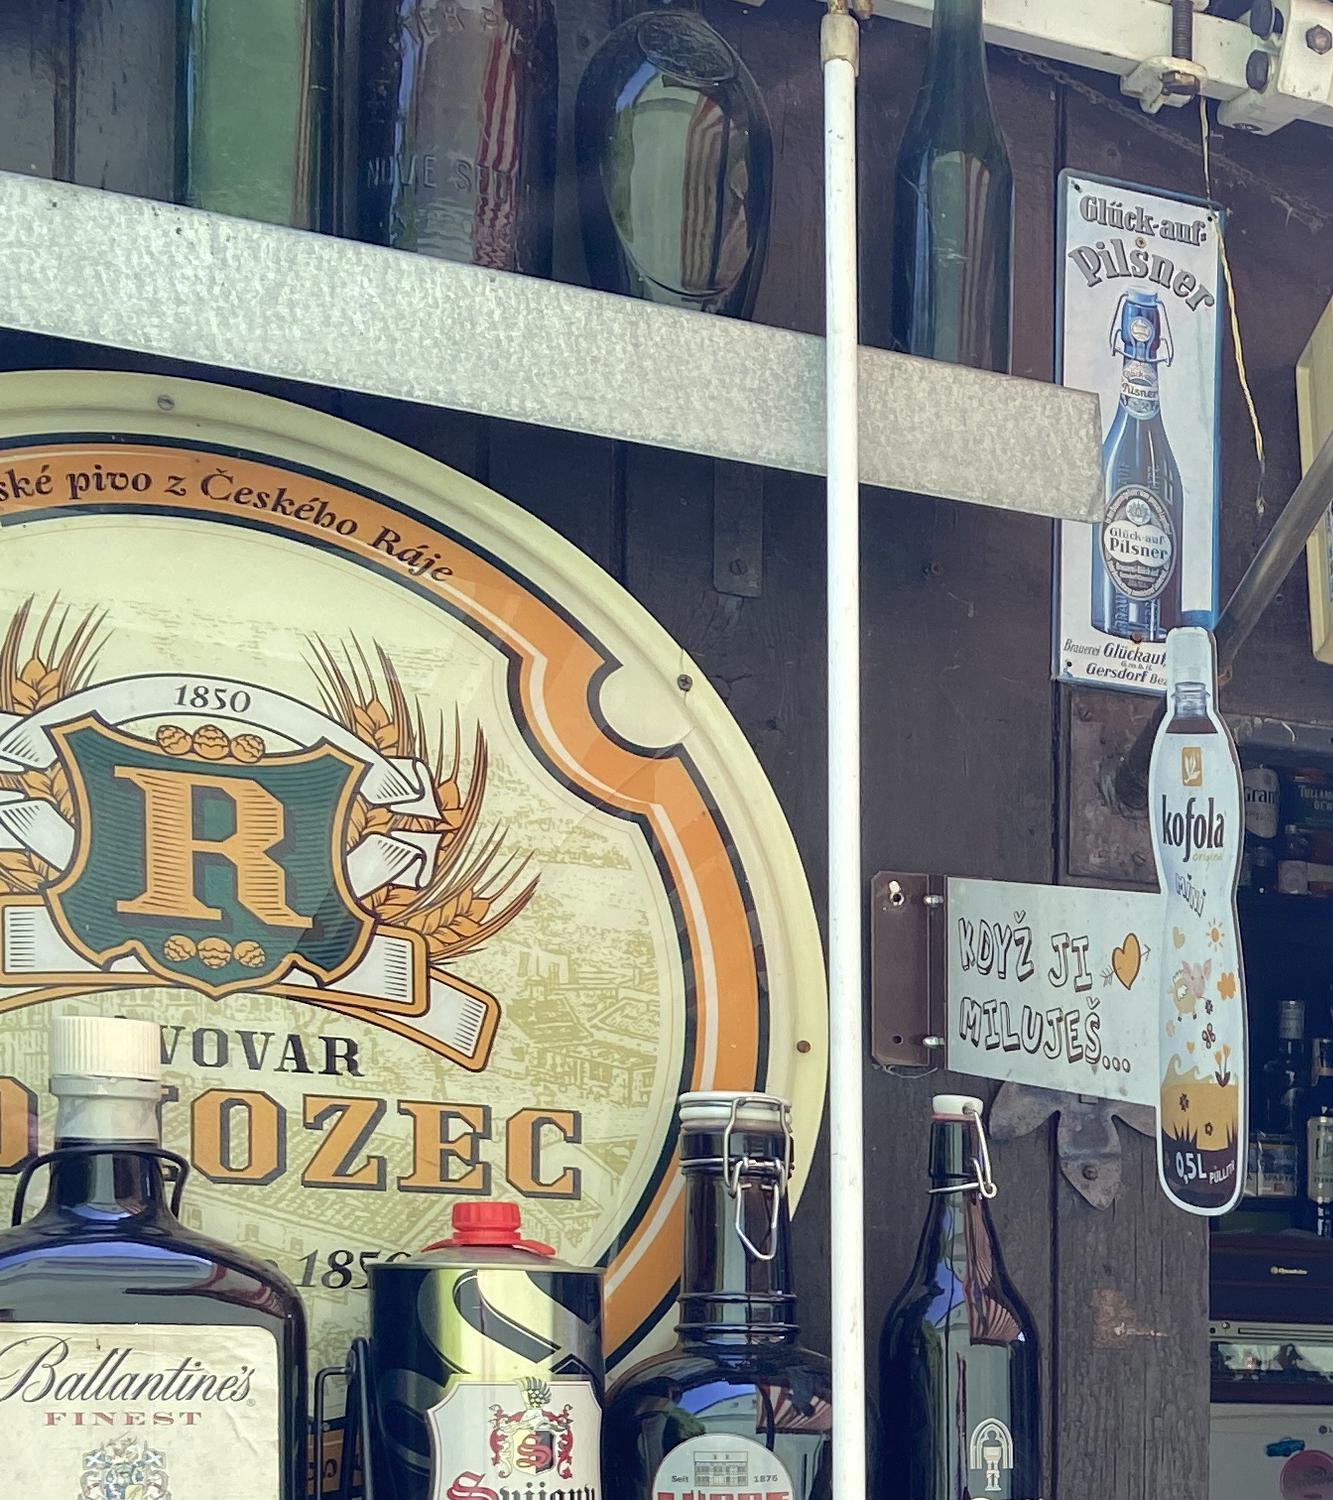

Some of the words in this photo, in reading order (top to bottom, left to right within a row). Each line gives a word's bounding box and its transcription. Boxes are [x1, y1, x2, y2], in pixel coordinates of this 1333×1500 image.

[1068, 238, 1216, 312] Pilsner
[67, 464, 151, 500] pivo
[164, 475, 188, 496] z
[200, 468, 358, 536] Českého
[367, 524, 456, 583] Ráje
[1110, 537, 1169, 561] Pilsner
[1064, 639, 1101, 656] Brauerei
[1086, 662, 1147, 684] Gersdorf
[174, 686, 252, 714] 1850
[114, 766, 313, 929] R
[1162, 794, 1225, 862] kofola
[958, 909, 1035, 983] KDYŽ
[1048, 931, 1093, 993] JI
[159, 1026, 364, 1078] VOVAR
[0, 1335, 256, 1403] Ballantine's
[45, 1411, 203, 1427] FINEST
[518, 1433, 550, 1468] S
[671, 1475, 689, 1484] Seit
[753, 1474, 778, 1484] 1876
